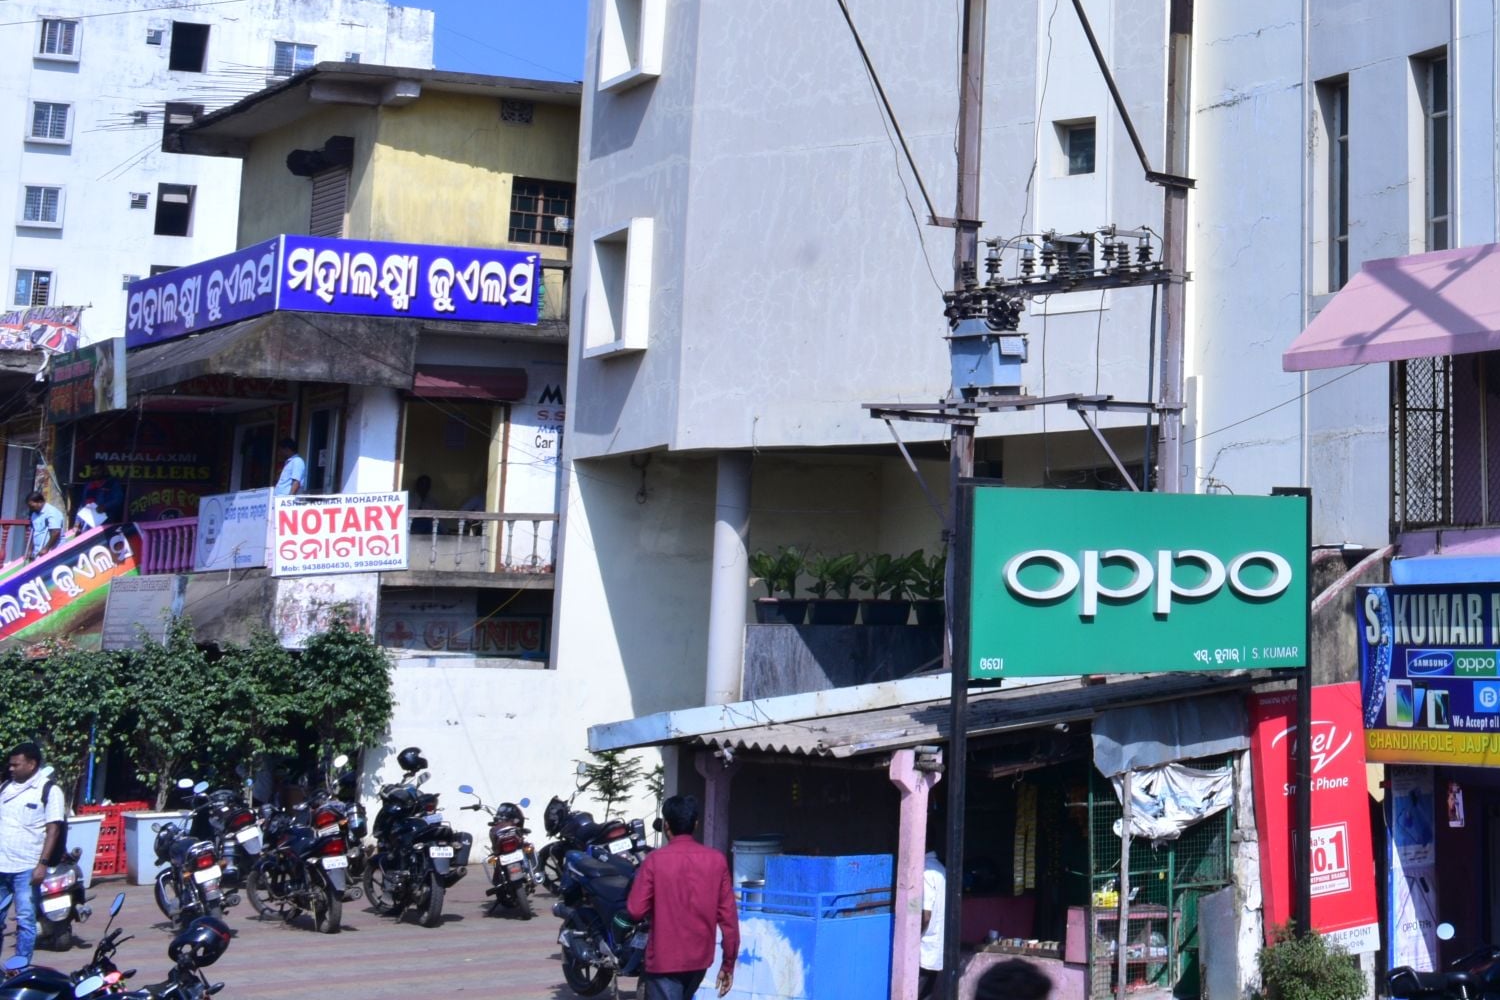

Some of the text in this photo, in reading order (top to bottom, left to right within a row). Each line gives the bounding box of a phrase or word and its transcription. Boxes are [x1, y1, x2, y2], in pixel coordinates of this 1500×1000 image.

[535, 434, 554, 449] Car
[95, 451, 198, 463] MAHALAXMI
[79, 464, 211, 479] JWELLERS
[345, 494, 401, 504] MOHAPATRA
[278, 504, 405, 536] NOTARY
[279, 533, 401, 561] ନୋଟାରୀ
[1003, 549, 1293, 616] oppo
[1393, 593, 1484, 646] KUMAR
[1263, 646, 1298, 658] KUMAR
[1413, 657, 1448, 667] SAMSUNG
[1456, 657, 1495, 673] oppo
[1453, 715, 1464, 728] We
[1465, 716, 1488, 731] Accept
[1489, 716, 1500, 728] all
[1368, 733, 1456, 754] CHANDIKHOLE,
[1316, 776, 1349, 791] Phone
[1349, 927, 1371, 940] POINT
